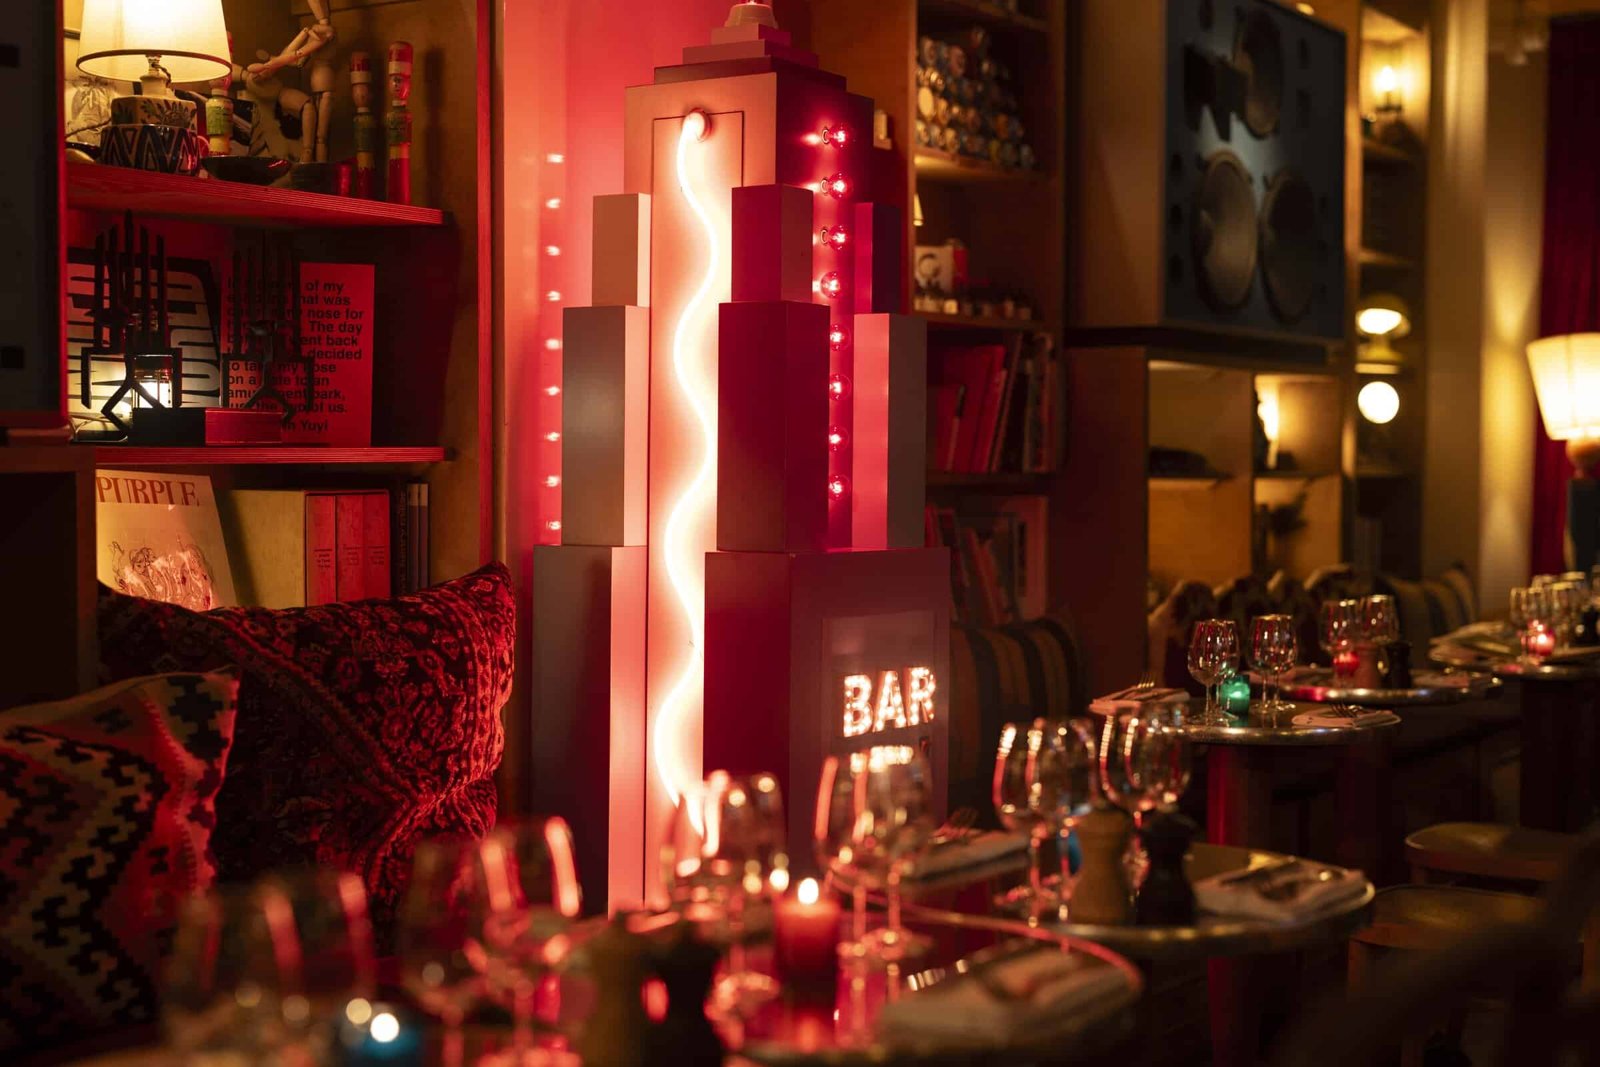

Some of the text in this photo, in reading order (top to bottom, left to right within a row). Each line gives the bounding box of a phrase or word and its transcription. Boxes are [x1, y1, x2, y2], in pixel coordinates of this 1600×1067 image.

[304, 280, 345, 295] of my
[323, 296, 351, 306] was
[307, 308, 365, 320] nose for
[309, 320, 363, 335] The day
[326, 334, 358, 347] back
[307, 348, 362, 361] decided
[303, 362, 337, 373] ose
[228, 375, 244, 385] on
[248, 375, 257, 385] a
[312, 376, 330, 386] an
[328, 403, 348, 413] us.
[301, 419, 328, 433] Yuyi
[95, 476, 200, 507] PURPLE
[843, 666, 937, 738] BAR
